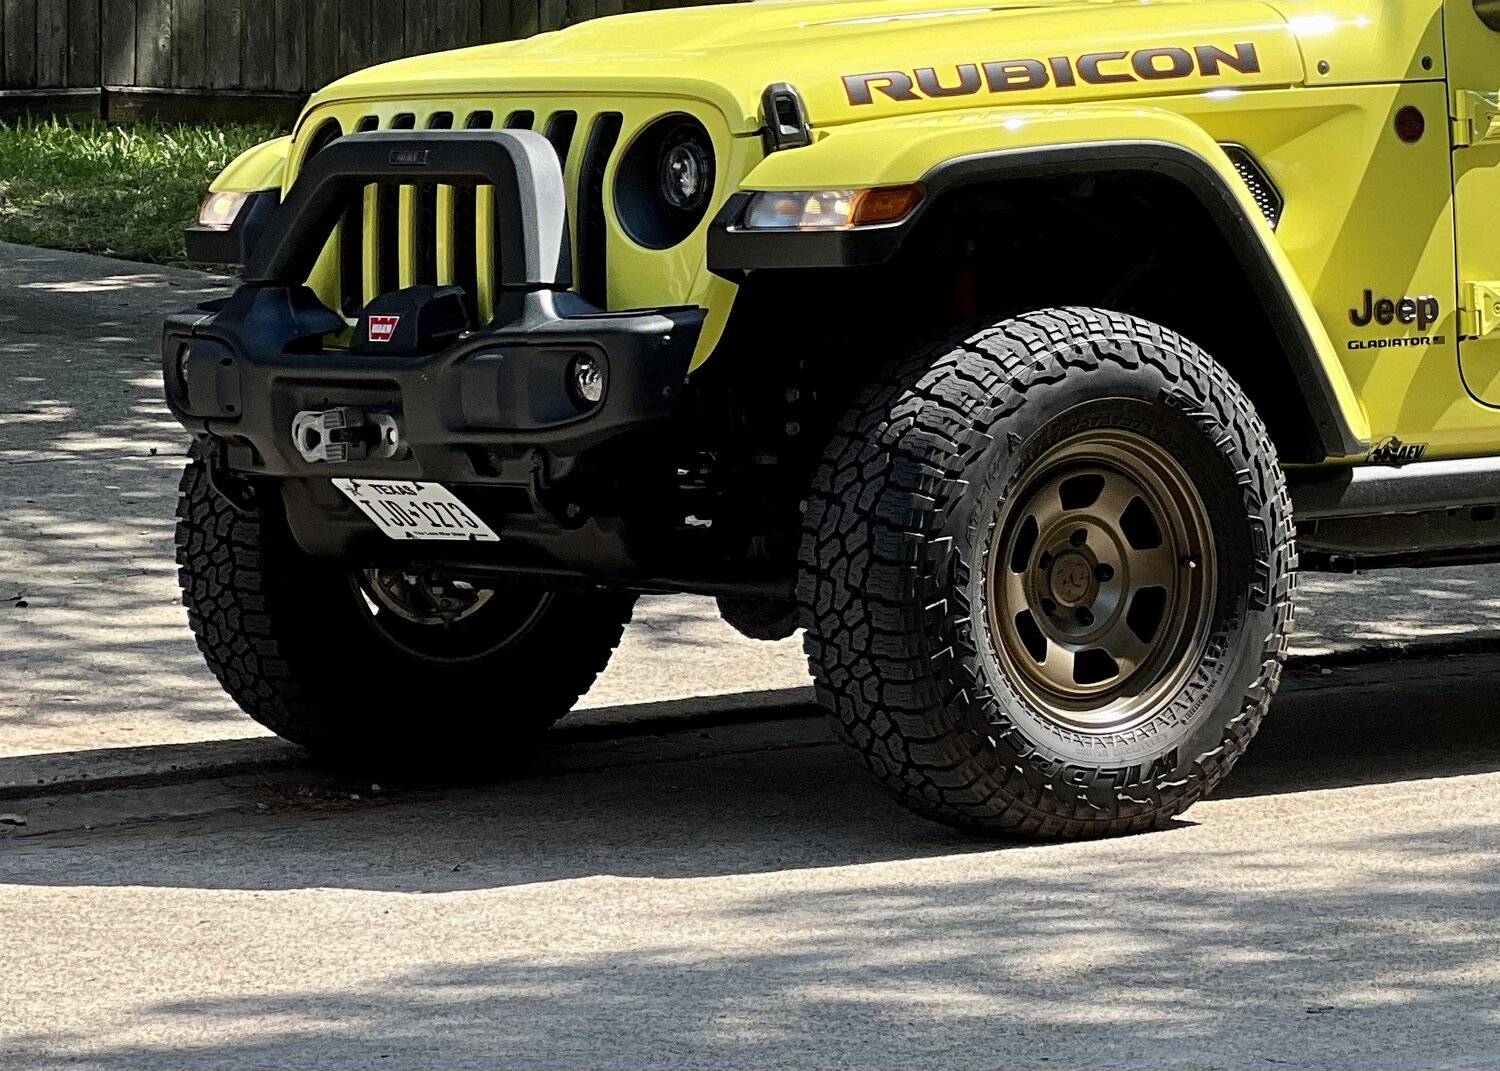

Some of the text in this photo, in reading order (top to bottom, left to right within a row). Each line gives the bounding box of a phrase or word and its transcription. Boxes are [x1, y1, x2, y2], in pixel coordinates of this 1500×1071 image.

[840, 42, 1261, 106] RUBICON
[1348, 289, 1440, 332] Jeep
[1347, 336, 1431, 349] GLADIATOR
[368, 483, 418, 496] TEXAS
